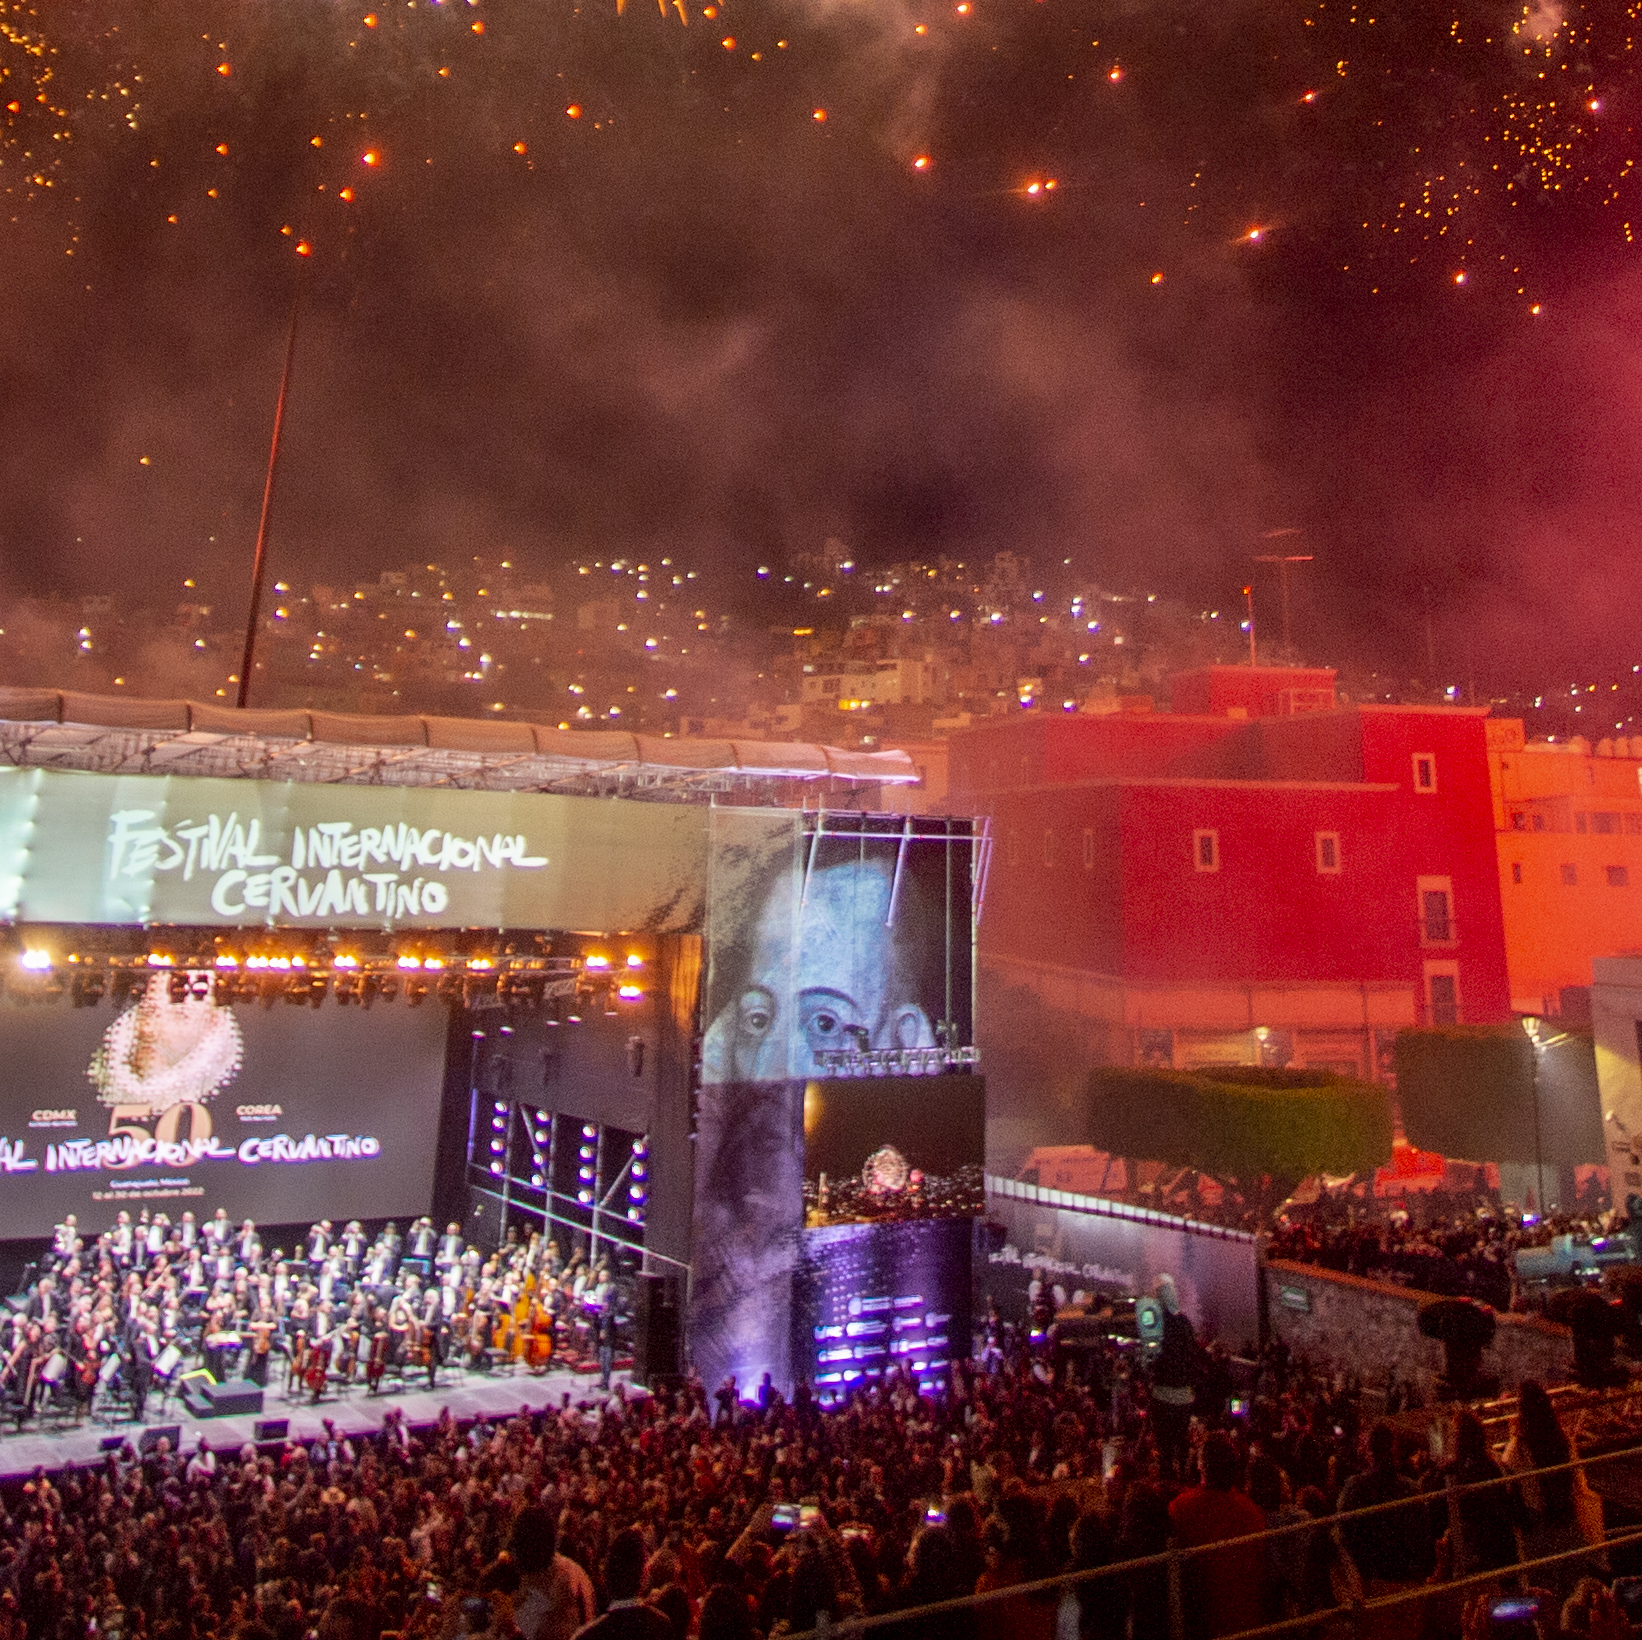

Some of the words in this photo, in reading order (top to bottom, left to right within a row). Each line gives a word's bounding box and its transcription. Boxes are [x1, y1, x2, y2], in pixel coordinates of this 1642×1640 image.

[109, 810, 281, 880] FESTIVAL
[292, 821, 548, 871] INTERNACIONAL
[211, 866, 449, 918] CERVANTINO
[31, 1110, 77, 1122] CDMX
[236, 1104, 283, 1116] COREA
[44, 1135, 236, 1173] INTERNACIONAL
[238, 1133, 381, 1164] CERVANTINO
[108, 1102, 213, 1171] 50
